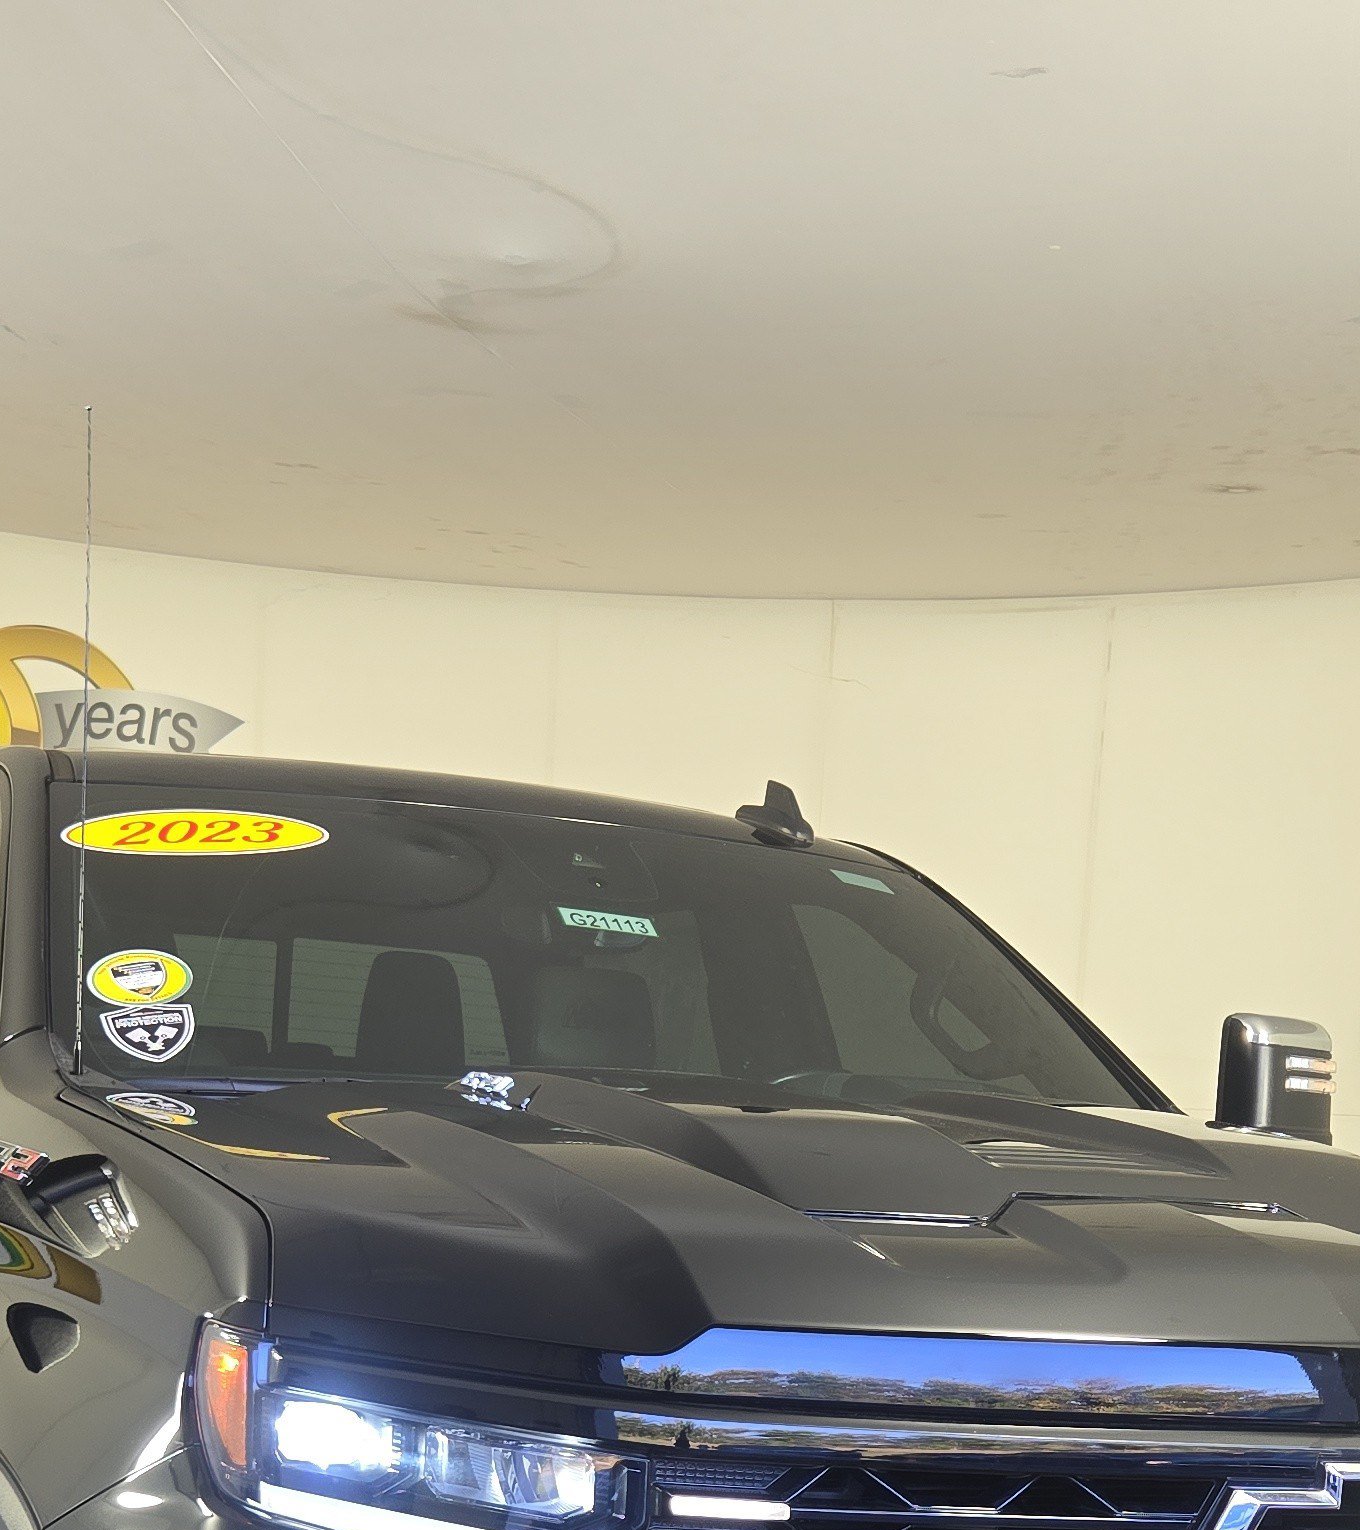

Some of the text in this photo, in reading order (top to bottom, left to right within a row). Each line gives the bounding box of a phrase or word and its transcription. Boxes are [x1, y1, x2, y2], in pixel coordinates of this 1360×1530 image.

[54, 692, 199, 754] years
[112, 820, 285, 846] 2023
[570, 912, 649, 934] G21113
